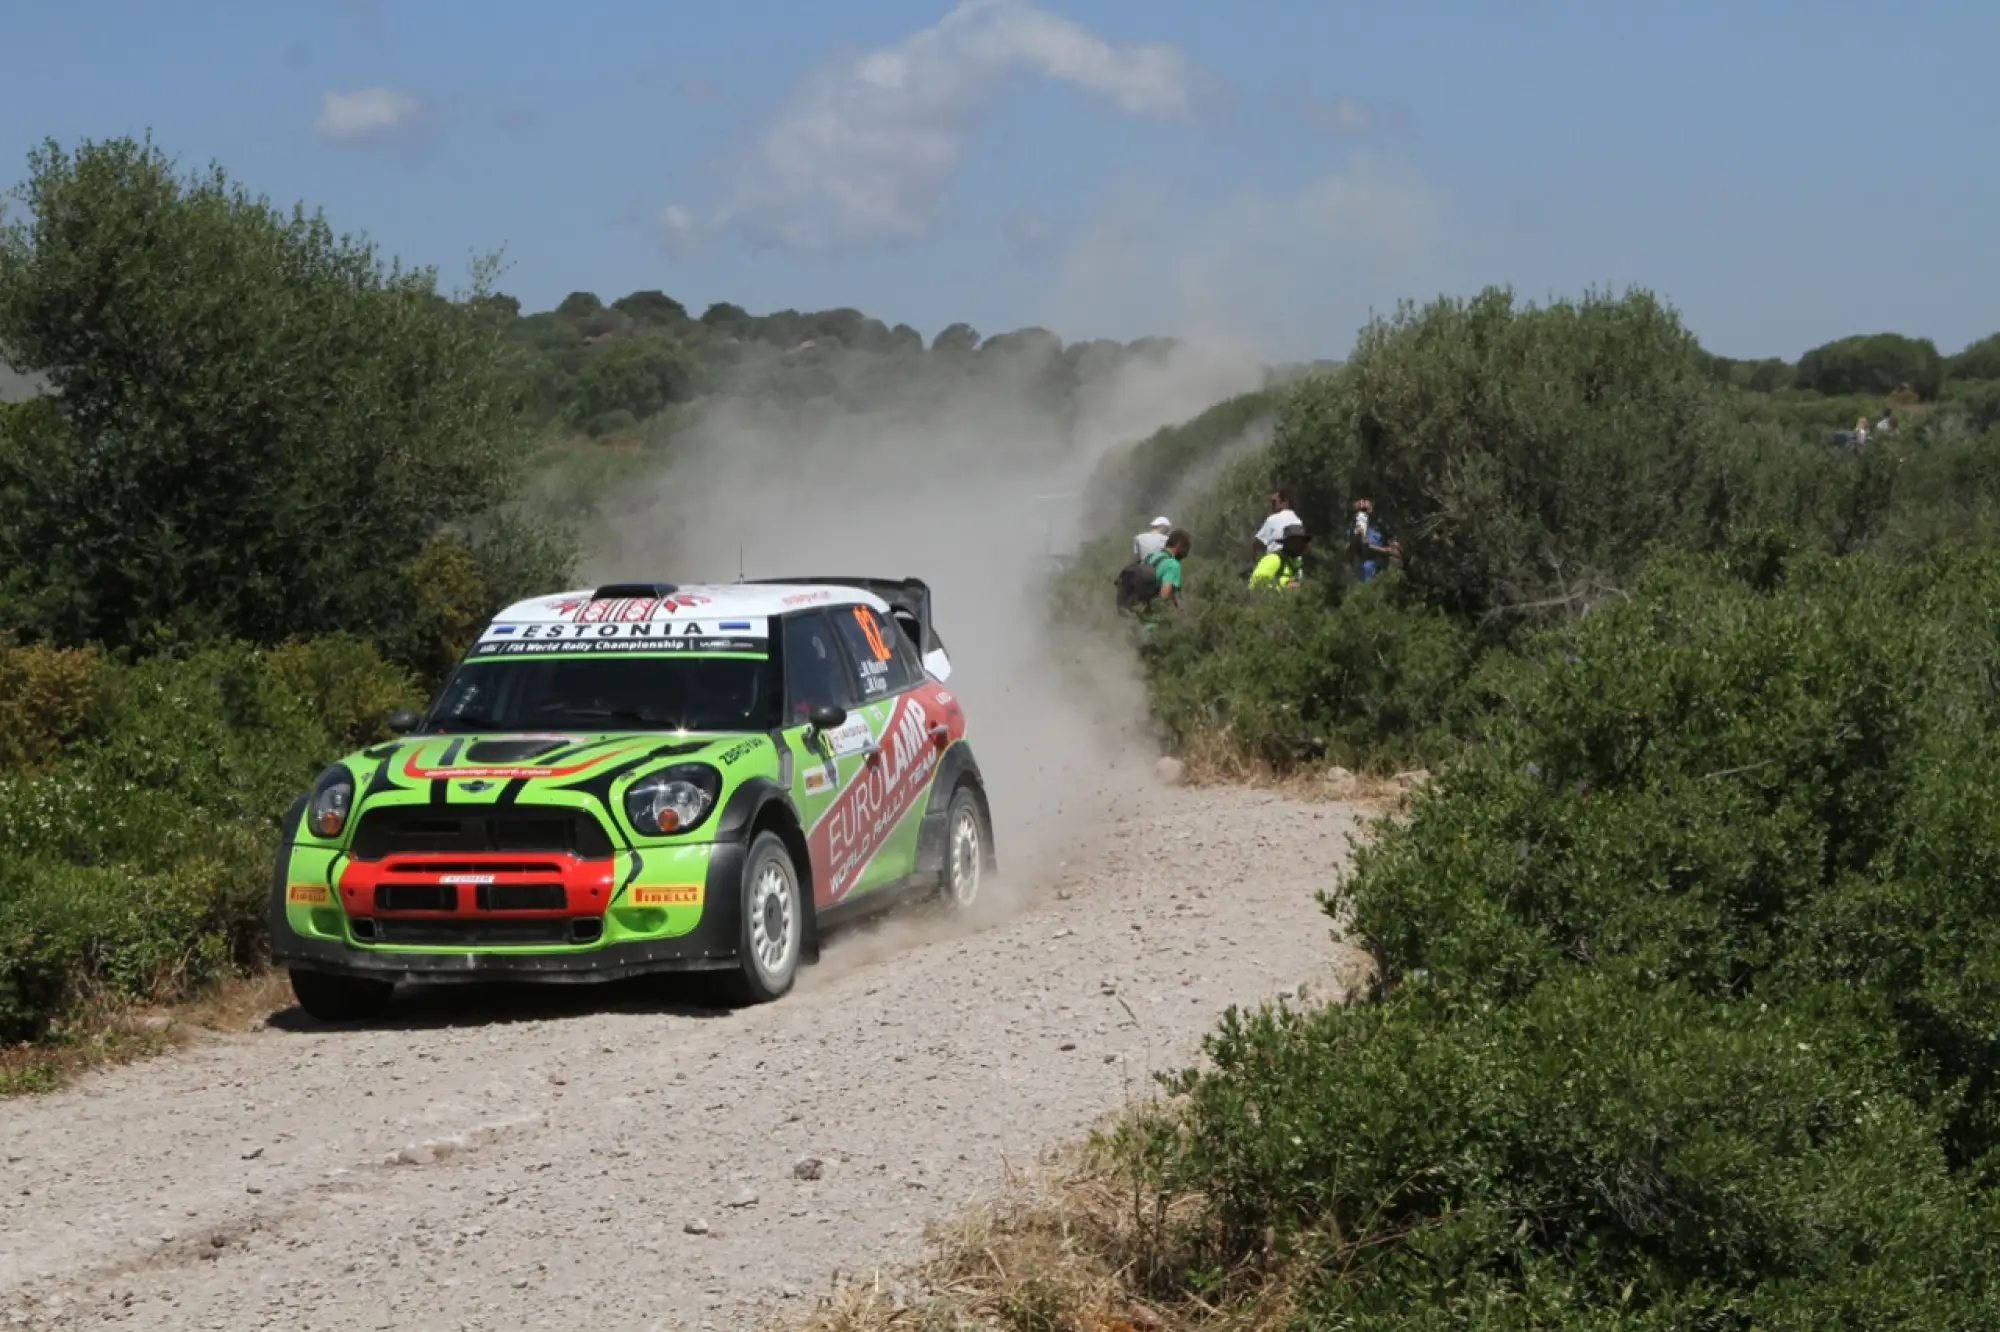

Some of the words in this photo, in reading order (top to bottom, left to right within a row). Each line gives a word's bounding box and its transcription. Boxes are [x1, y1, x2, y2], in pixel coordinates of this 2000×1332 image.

[522, 622, 703, 638] ESTONIA
[507, 643, 525, 653] FIA
[526, 642, 561, 652] World
[561, 641, 592, 652] Rally
[595, 640, 685, 651] Championship
[829, 697, 929, 866] EUROLAMP
[829, 832, 870, 895] WORLD
[872, 784, 906, 841] RALLY
[908, 745, 937, 791] TEAM
[290, 886, 326, 902] PIRELLI
[635, 886, 698, 903] PIRELLI
